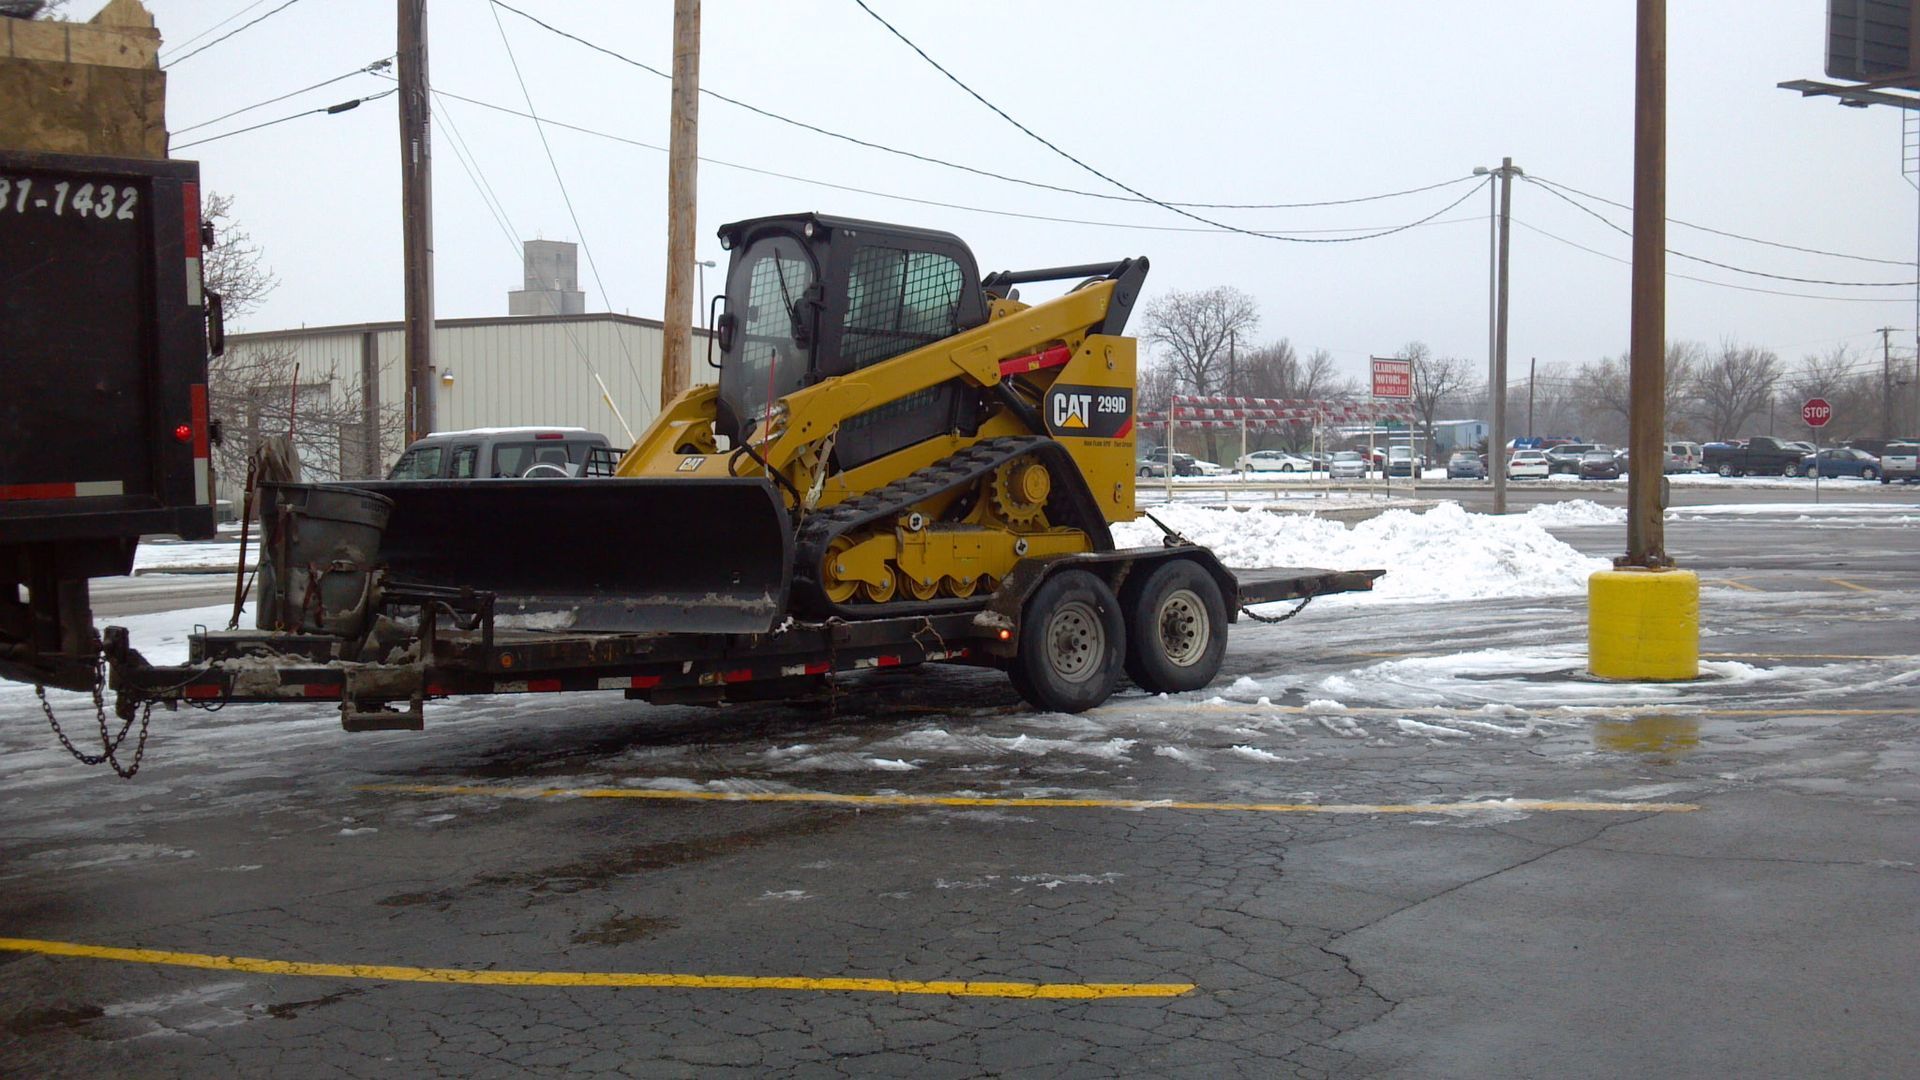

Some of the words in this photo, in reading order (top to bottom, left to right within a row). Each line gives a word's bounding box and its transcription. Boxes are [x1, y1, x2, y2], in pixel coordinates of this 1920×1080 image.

[1375, 374, 1401, 385] MOTORS
[1054, 393, 1092, 428] CAT
[1098, 395, 1127, 413] 299D
[1804, 406, 1830, 418] STOP
[678, 457, 705, 471] CAT
